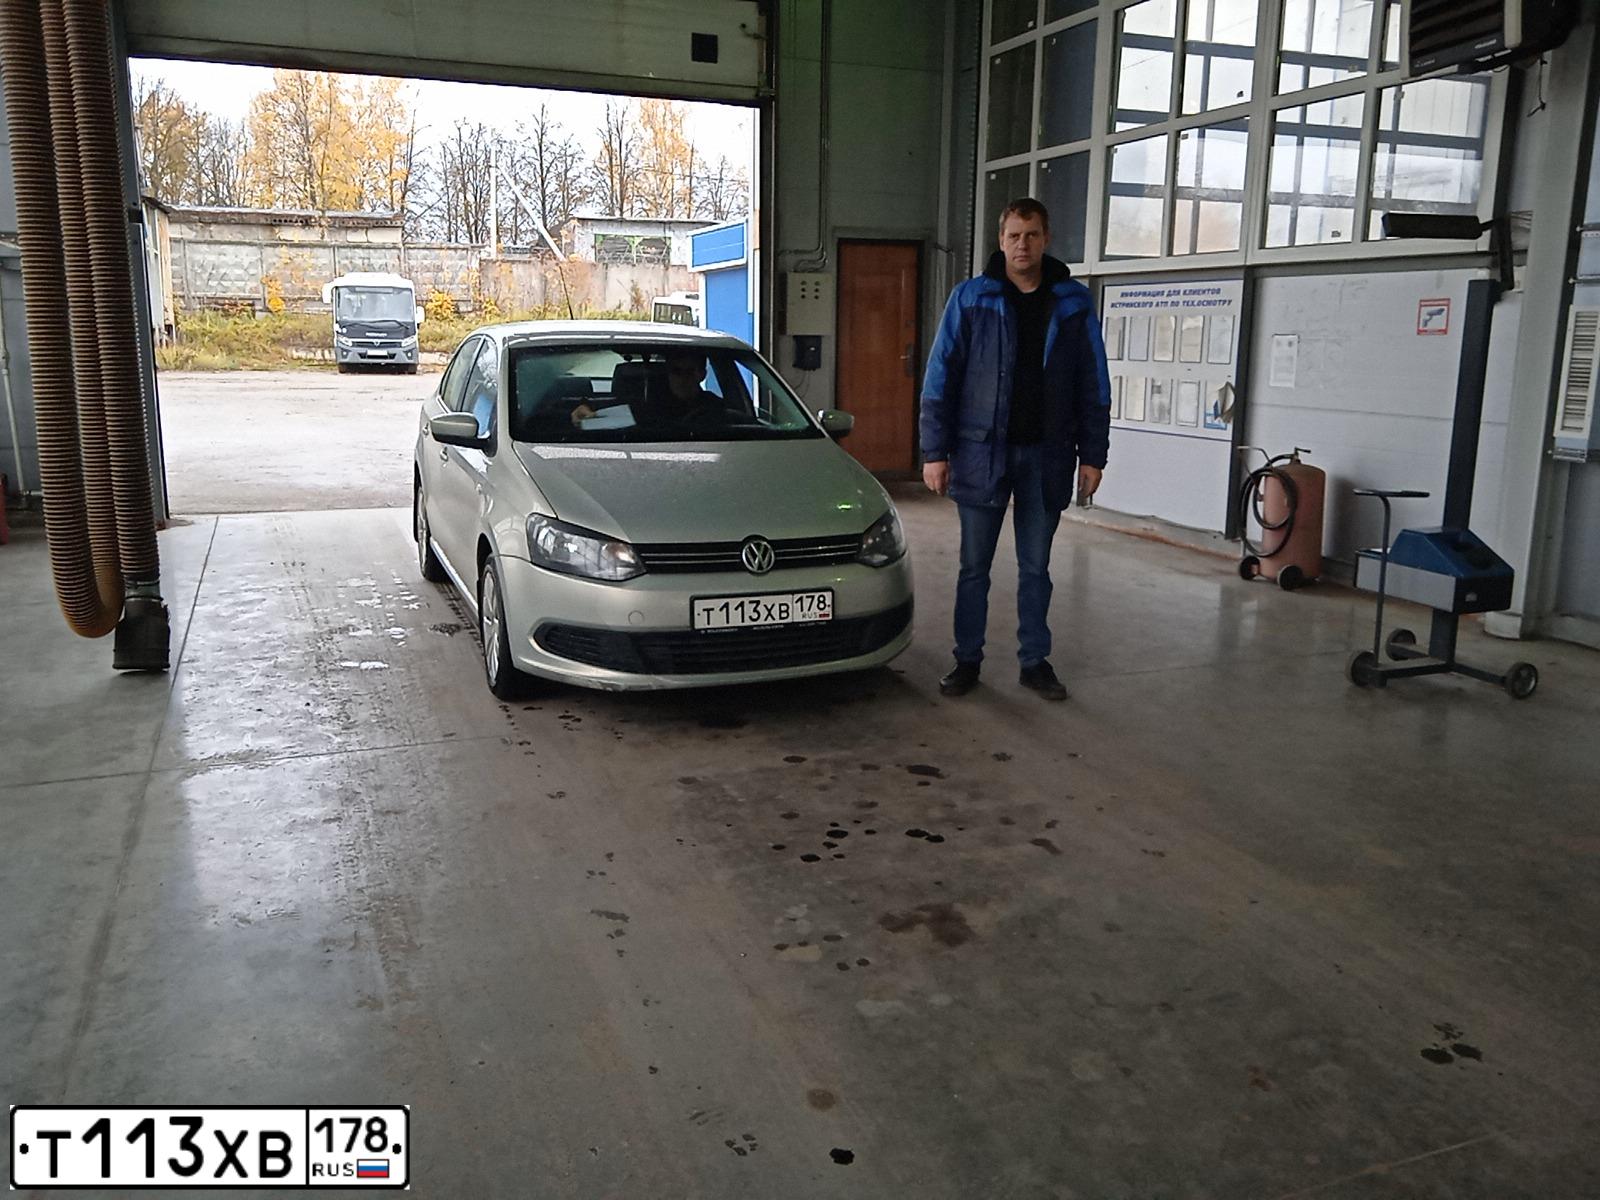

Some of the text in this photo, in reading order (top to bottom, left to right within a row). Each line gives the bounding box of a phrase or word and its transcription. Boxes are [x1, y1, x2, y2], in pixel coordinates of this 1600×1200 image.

[1120, 288, 1221, 298] ИНФОРМАЦИЯ ДЛЯ КЛИЕНТОВ
[1155, 300, 1168, 308] АТП
[1169, 300, 1180, 308] ПО
[795, 594, 827, 613] 178
